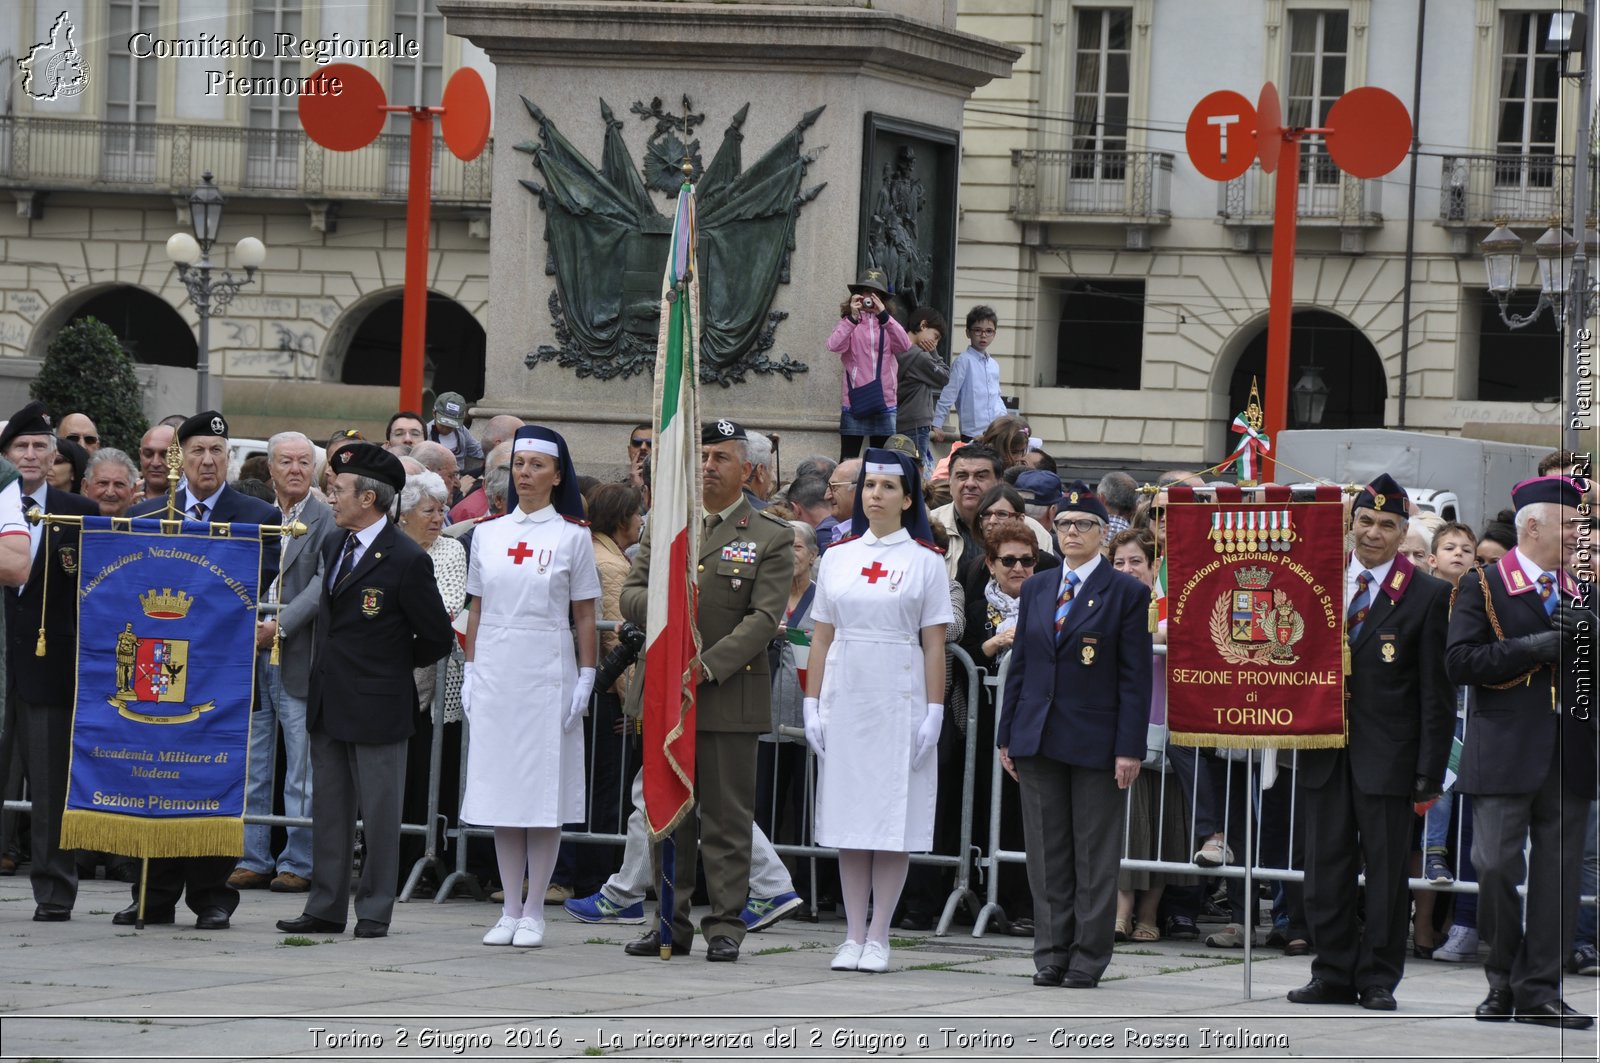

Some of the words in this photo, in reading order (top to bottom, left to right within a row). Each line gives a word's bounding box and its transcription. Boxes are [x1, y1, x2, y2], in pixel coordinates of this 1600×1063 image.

[1206, 114, 1240, 164] T
[79, 550, 144, 601] Associazione
[148, 545, 210, 568] Nazionale
[209, 563, 257, 611] ex-allievi
[1172, 559, 1221, 625] Associazione
[1222, 551, 1279, 565] Nazionale
[1280, 557, 1314, 585] Polizia
[1312, 584, 1326, 596] di
[1320, 595, 1336, 629] Stato
[1172, 668, 1233, 685] SEZIONE
[1238, 670, 1337, 686] PROVINCIALE
[1246, 691, 1258, 702] di
[1213, 708, 1293, 726] TORINO
[90, 746, 154, 761] Accademia
[157, 751, 211, 763] Militare
[214, 752, 228, 763] di
[130, 766, 180, 779] Modena
[92, 791, 145, 808] Sezione
[148, 795, 220, 811] Piemonte
